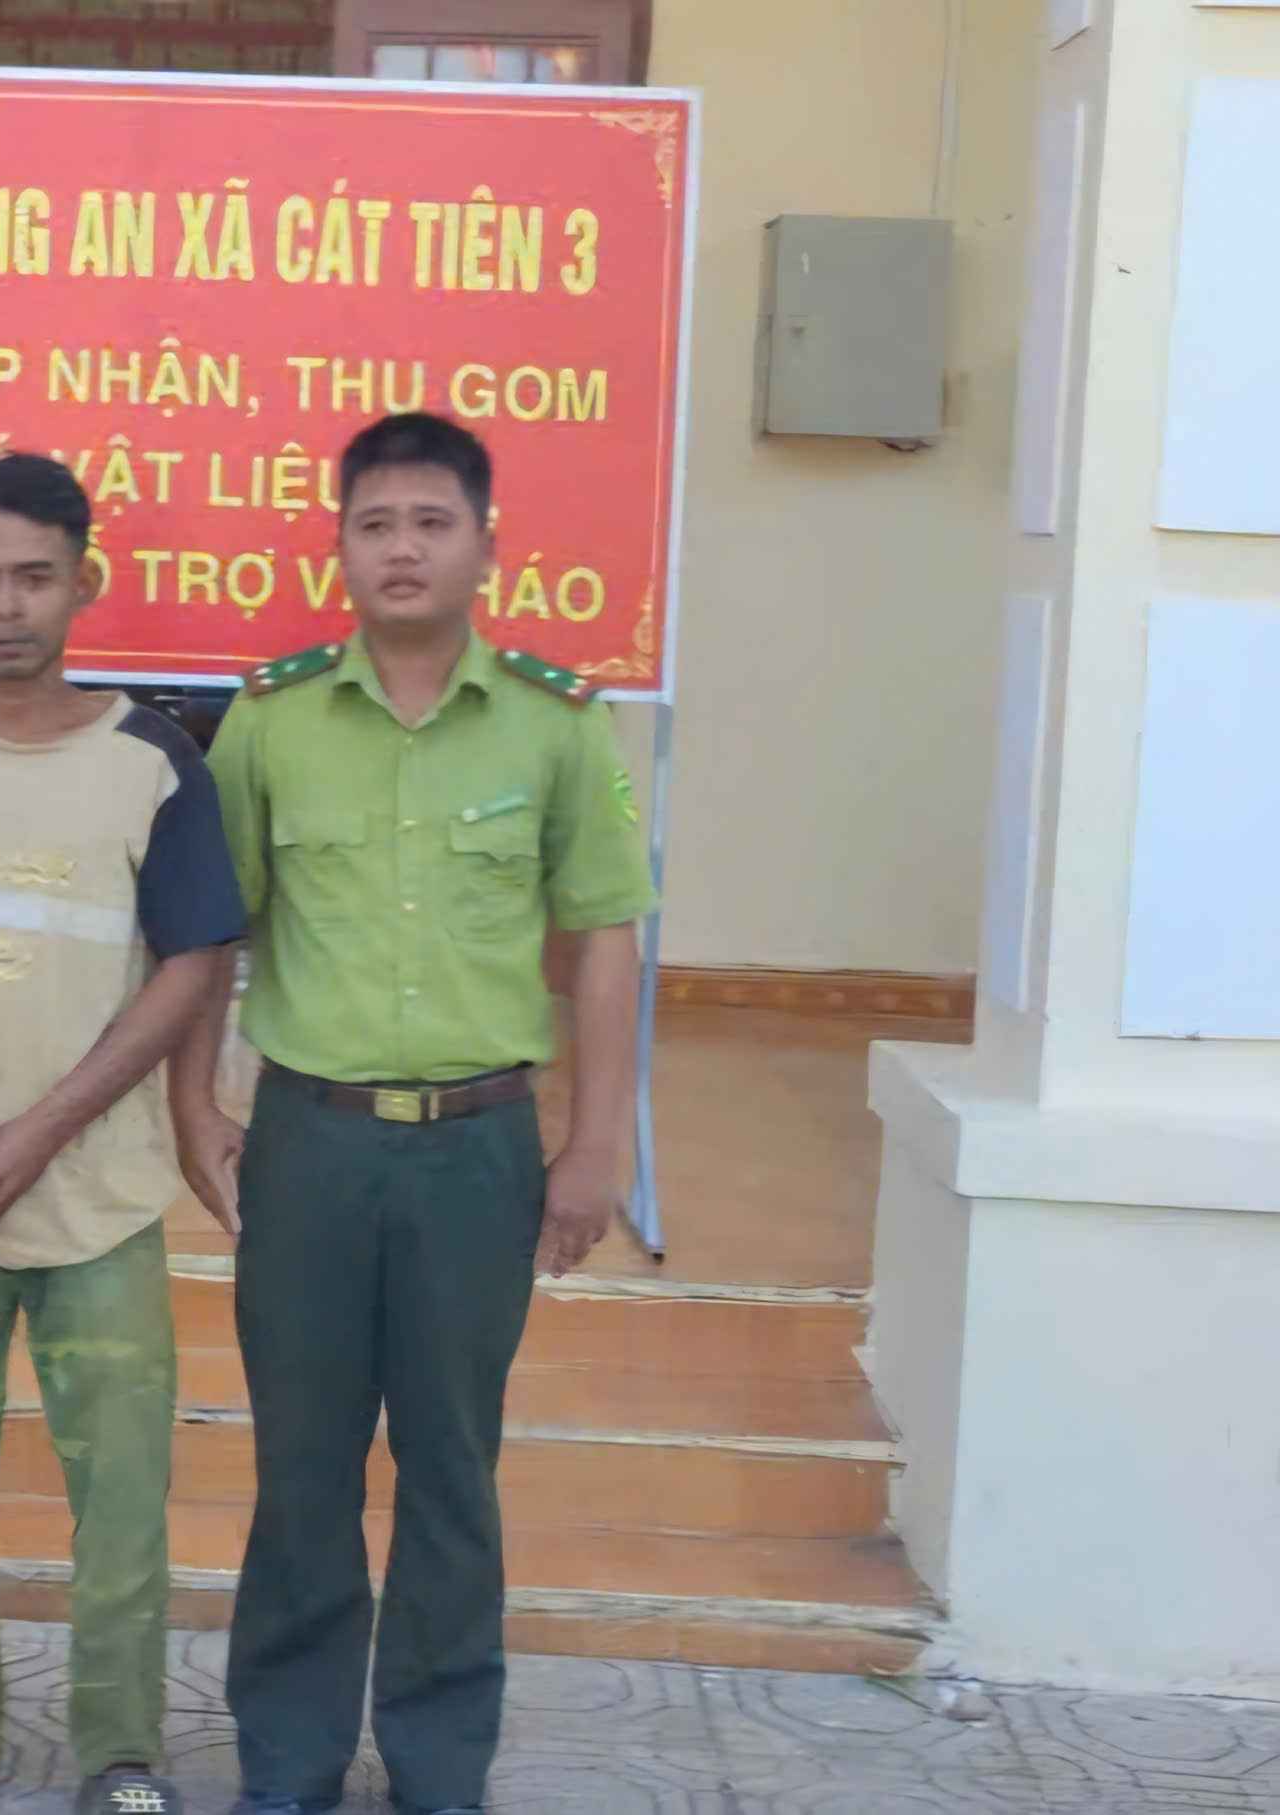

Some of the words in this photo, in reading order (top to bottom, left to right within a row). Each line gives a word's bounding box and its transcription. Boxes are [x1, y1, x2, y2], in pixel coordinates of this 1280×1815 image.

[69, 190, 155, 277] AN
[174, 177, 255, 281] XÃ
[276, 178, 391, 286] CÁT
[409, 184, 544, 293] TIÊN
[560, 208, 600, 295] 3
[48, 337, 260, 418] NHẬN,
[286, 356, 425, 414] THU
[449, 362, 608, 422] GOM
[132, 548, 276, 619] TRỢ
